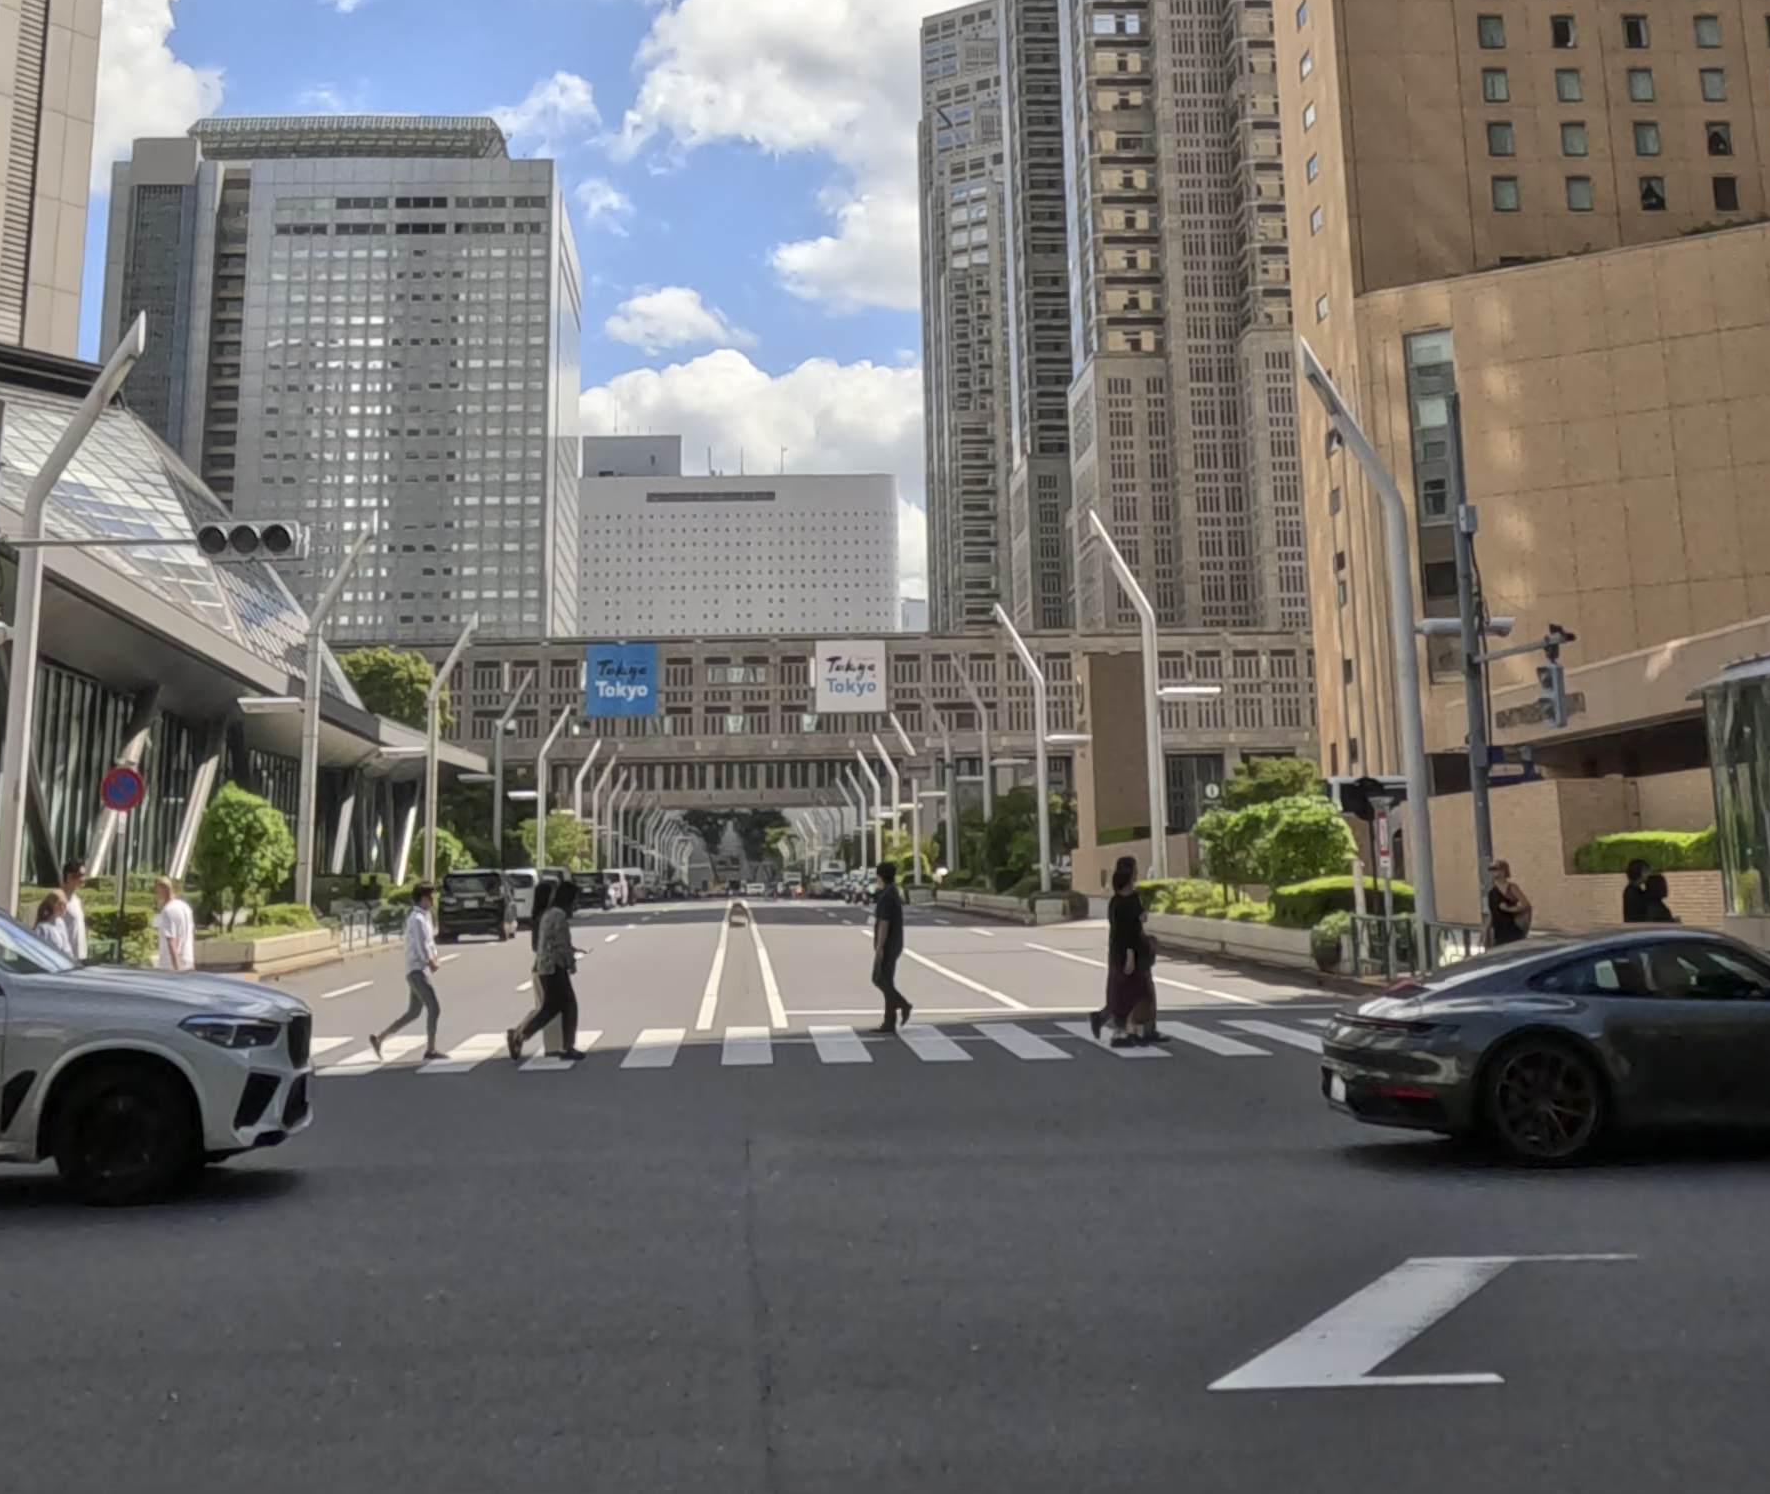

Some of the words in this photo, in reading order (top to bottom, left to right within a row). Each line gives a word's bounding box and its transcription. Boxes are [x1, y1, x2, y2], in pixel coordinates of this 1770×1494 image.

[596, 659, 647, 684] Tokyo
[825, 656, 876, 681] Tokyo
[595, 680, 648, 702] Tokyo
[825, 677, 877, 697] Tokyo
